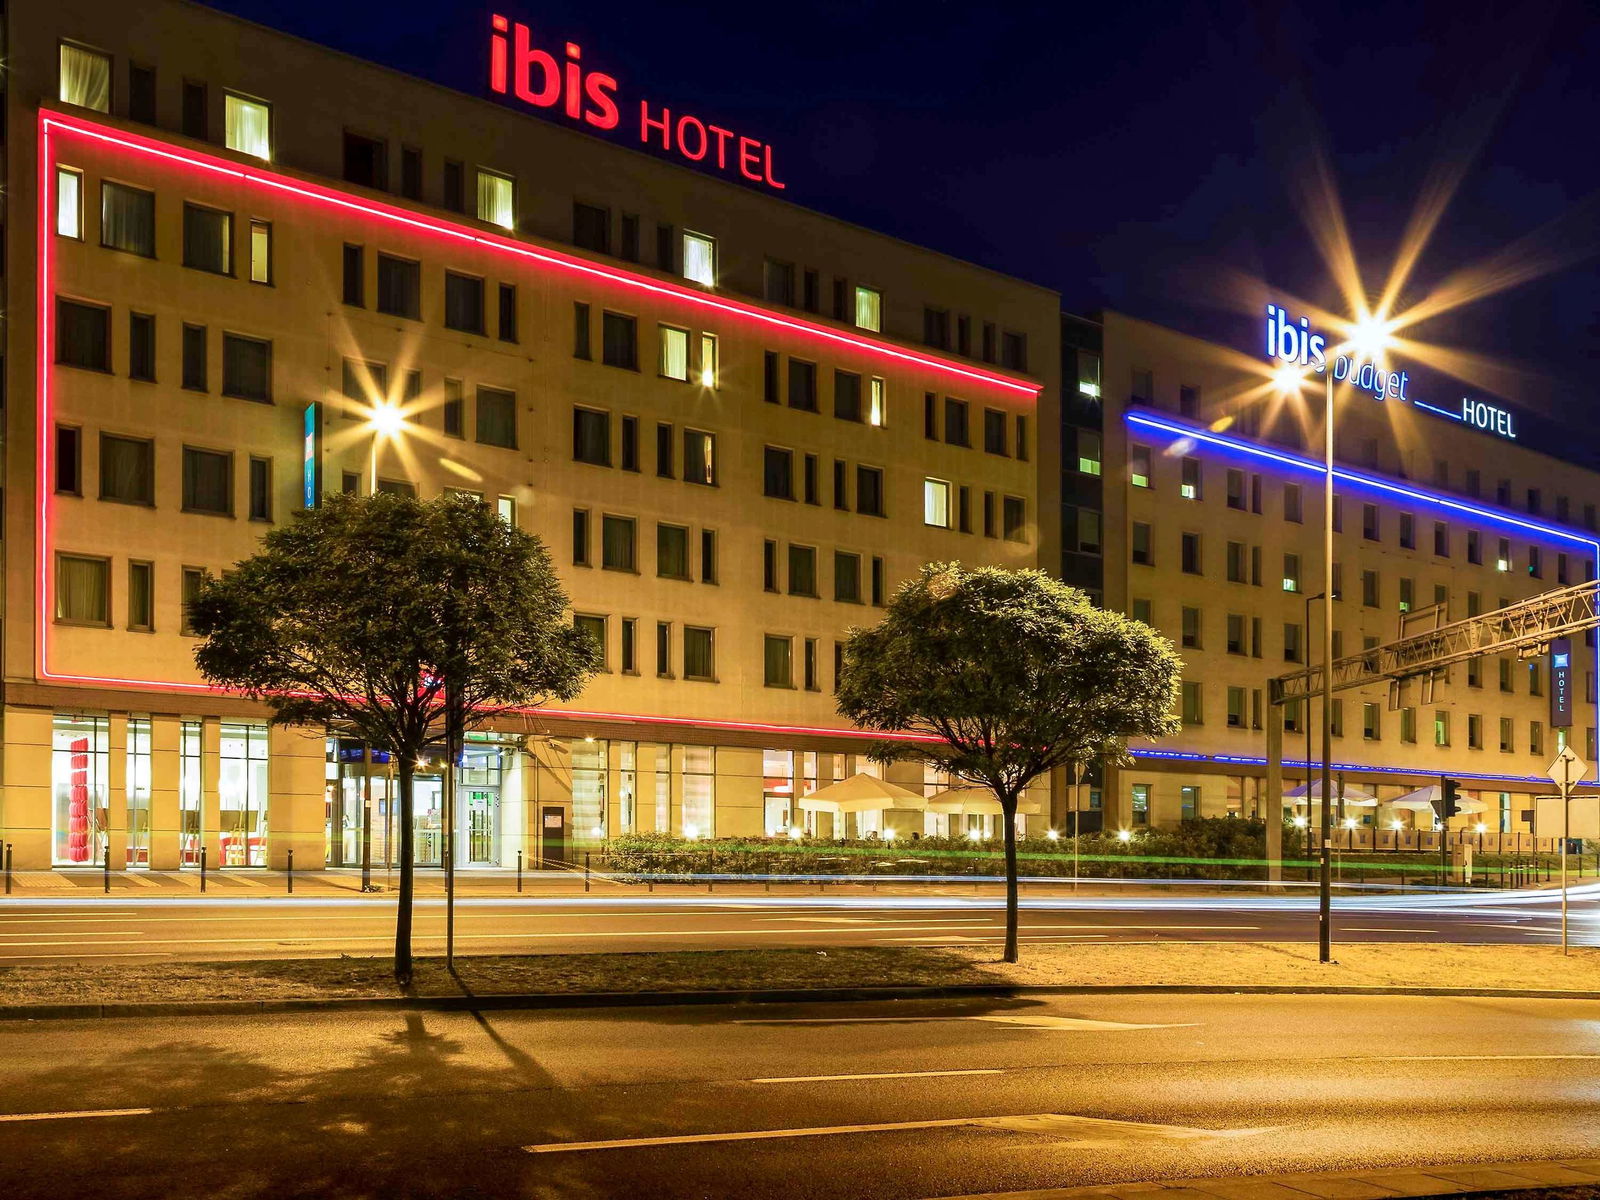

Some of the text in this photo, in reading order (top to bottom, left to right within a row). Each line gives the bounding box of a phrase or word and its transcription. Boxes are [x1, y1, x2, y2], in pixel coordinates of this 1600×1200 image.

[491, 13, 786, 189] ibis HOTEL
[1267, 303, 1327, 374] ibis
[1462, 397, 1517, 439] HOTEL
